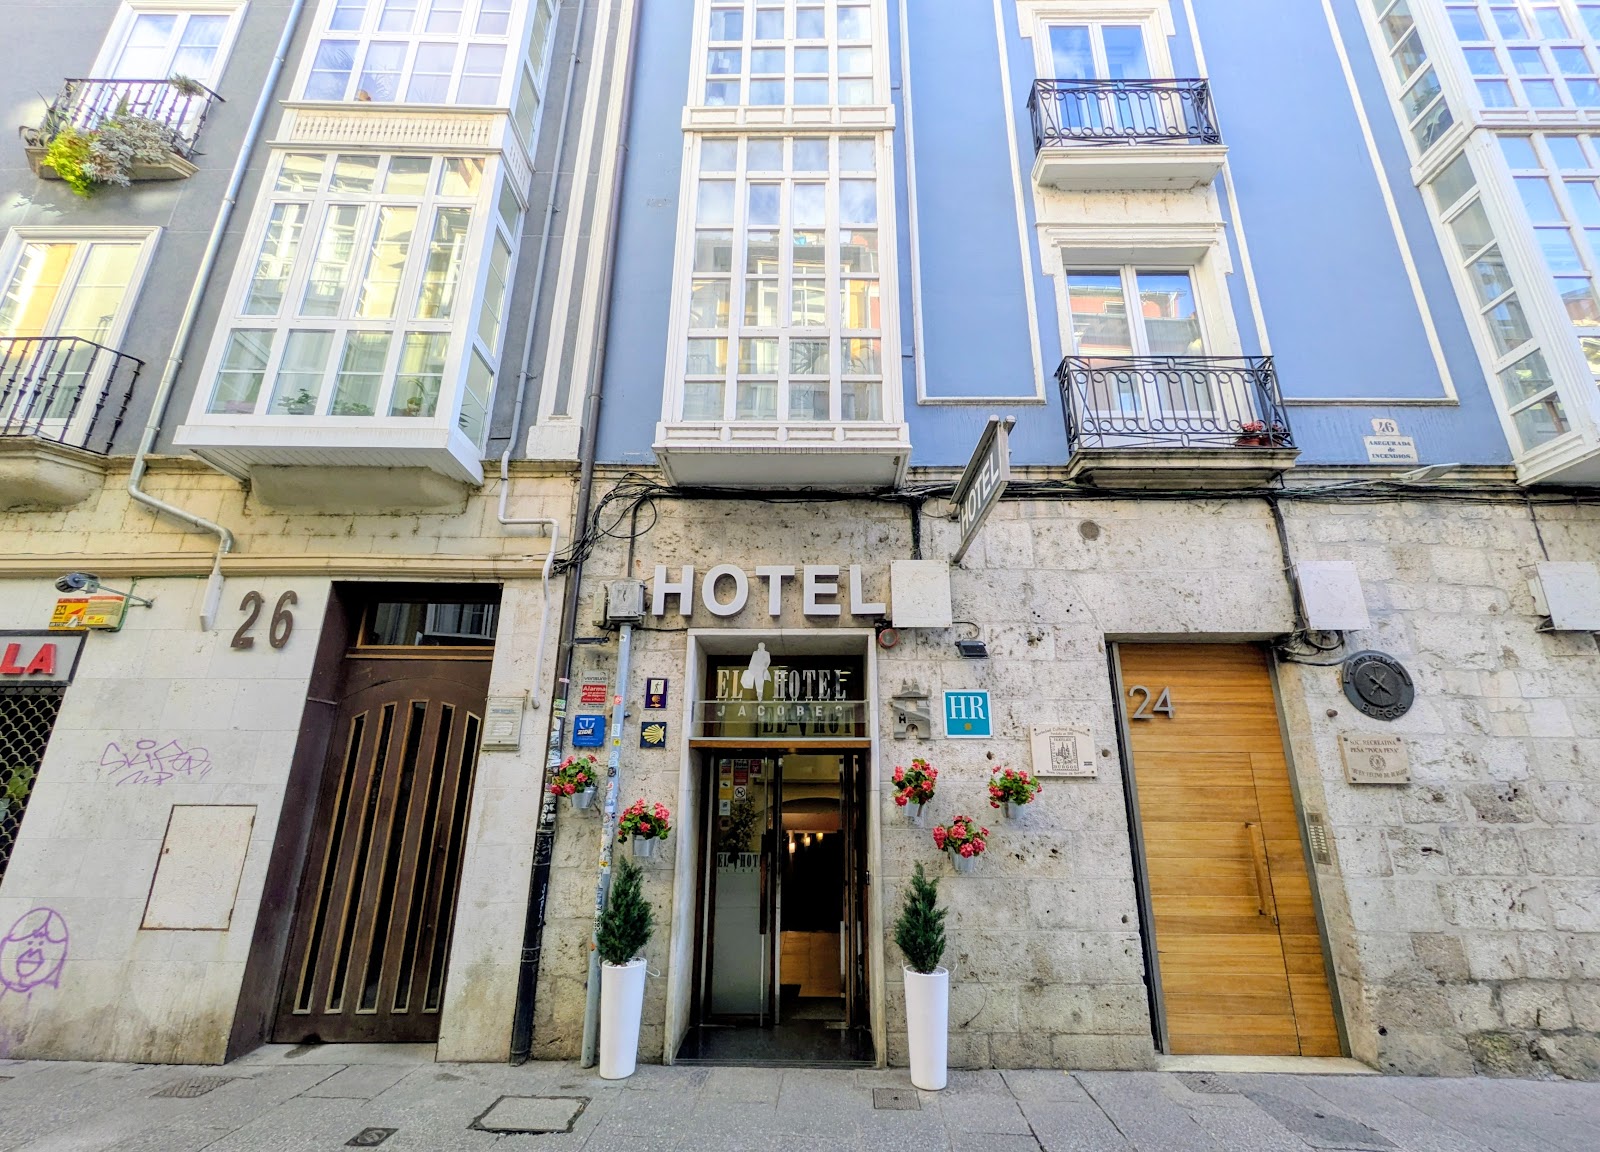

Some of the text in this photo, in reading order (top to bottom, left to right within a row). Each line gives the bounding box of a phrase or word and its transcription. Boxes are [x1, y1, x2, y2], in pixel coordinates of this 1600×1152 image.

[961, 451, 999, 536] HOTEL
[651, 564, 887, 616] HOTEL
[230, 590, 298, 649] 26
[0, 643, 57, 675] LA
[716, 669, 847, 699] EL HOTEL
[948, 695, 986, 720] HR
[1129, 685, 1175, 719] 24
[1361, 702, 1407, 718] BURGOS
[717, 854, 728, 867] EL
